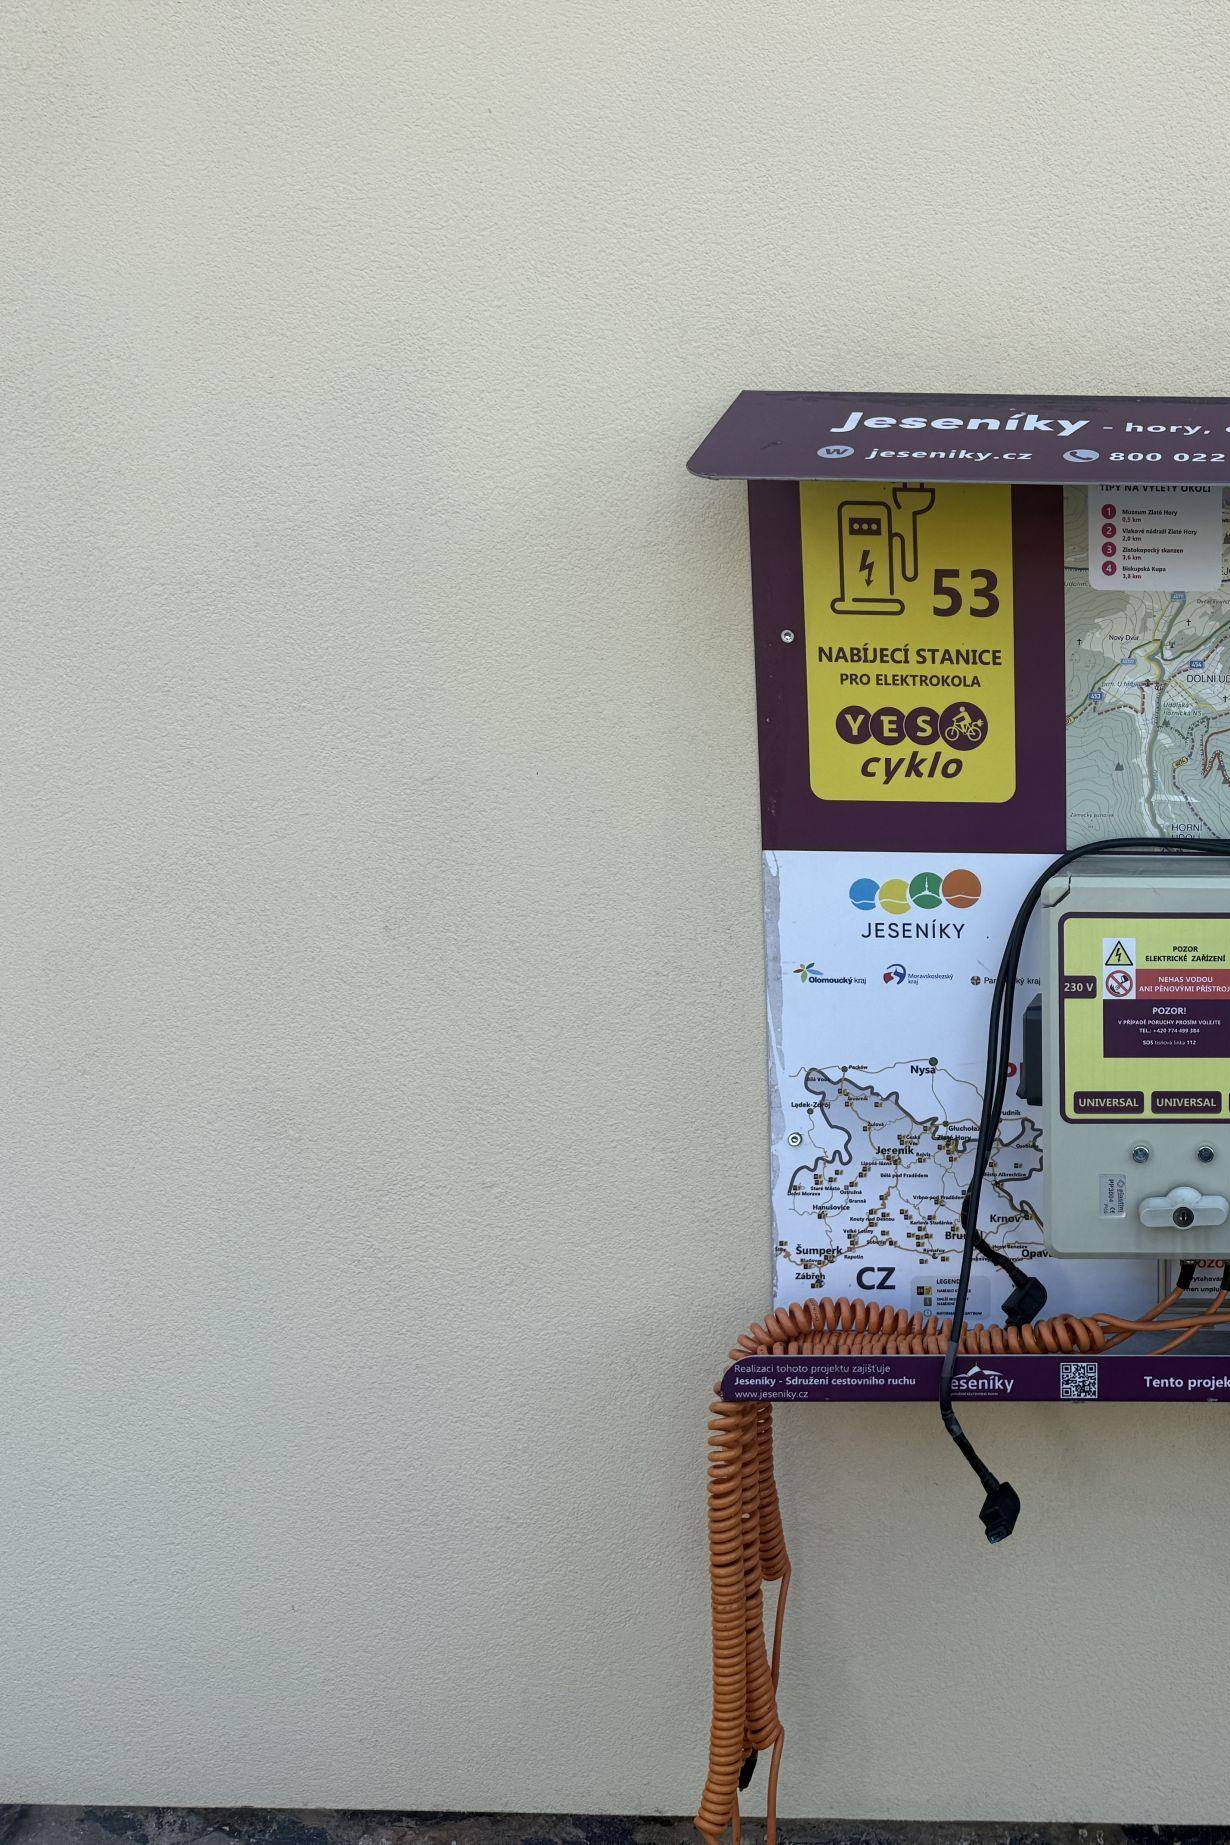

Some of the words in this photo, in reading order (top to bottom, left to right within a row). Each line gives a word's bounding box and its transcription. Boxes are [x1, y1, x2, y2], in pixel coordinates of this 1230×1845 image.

[830, 411, 1090, 436] Jeseníky
[1125, 422, 1211, 436] hory,
[865, 448, 1033, 462] jeseniky.cz
[1109, 451, 1162, 462] 800
[1173, 452, 1225, 463] 022
[932, 568, 1000, 618] 53
[817, 642, 909, 665] NABÍJECÍ
[916, 648, 1002, 666] STANICE
[840, 672, 870, 687] PRO
[875, 672, 981, 688] ELEKTROKOLA
[844, 713, 934, 737] YES
[860, 751, 964, 785] cyklo
[861, 918, 966, 939] JESENÍKY
[1173, 945, 1198, 953] POZOR
[1145, 954, 1188, 962] ELEKTRICKÉ
[1191, 954, 1226, 962] ZAŘÍZENÍ
[808, 976, 854, 985] Olomoucký
[854, 976, 867, 985] kraj
[907, 973, 954, 981] Moravskoslezský
[1027, 976, 1041, 986] kraj
[1064, 982, 1083, 992] 230
[1085, 982, 1094, 992] V
[1152, 1007, 1187, 1015] POZOR!
[910, 1065, 936, 1077] Nysa
[1078, 1097, 1139, 1107] UNIVERSAL
[1156, 1097, 1217, 1107] UNIVERSAL
[875, 1146, 914, 1155] Jeseník
[990, 1214, 1022, 1223] Krnov
[795, 1243, 843, 1256] Šumperk
[856, 1266, 896, 1290] CZ
[734, 1364, 774, 1373] Realizaci
[776, 1365, 808, 1373] tohoto
[810, 1364, 849, 1375] projektu
[852, 1364, 891, 1375] zajišťuje
[734, 1376, 775, 1387] Jeseníky
[785, 1376, 829, 1385] Sdružení
[831, 1376, 885, 1385] cestovního
[887, 1377, 916, 1385] ruchu
[951, 1376, 1014, 1393] eseníky
[1144, 1376, 1184, 1388] Tento
[734, 1390, 809, 1400] www.jeseniky.cz
